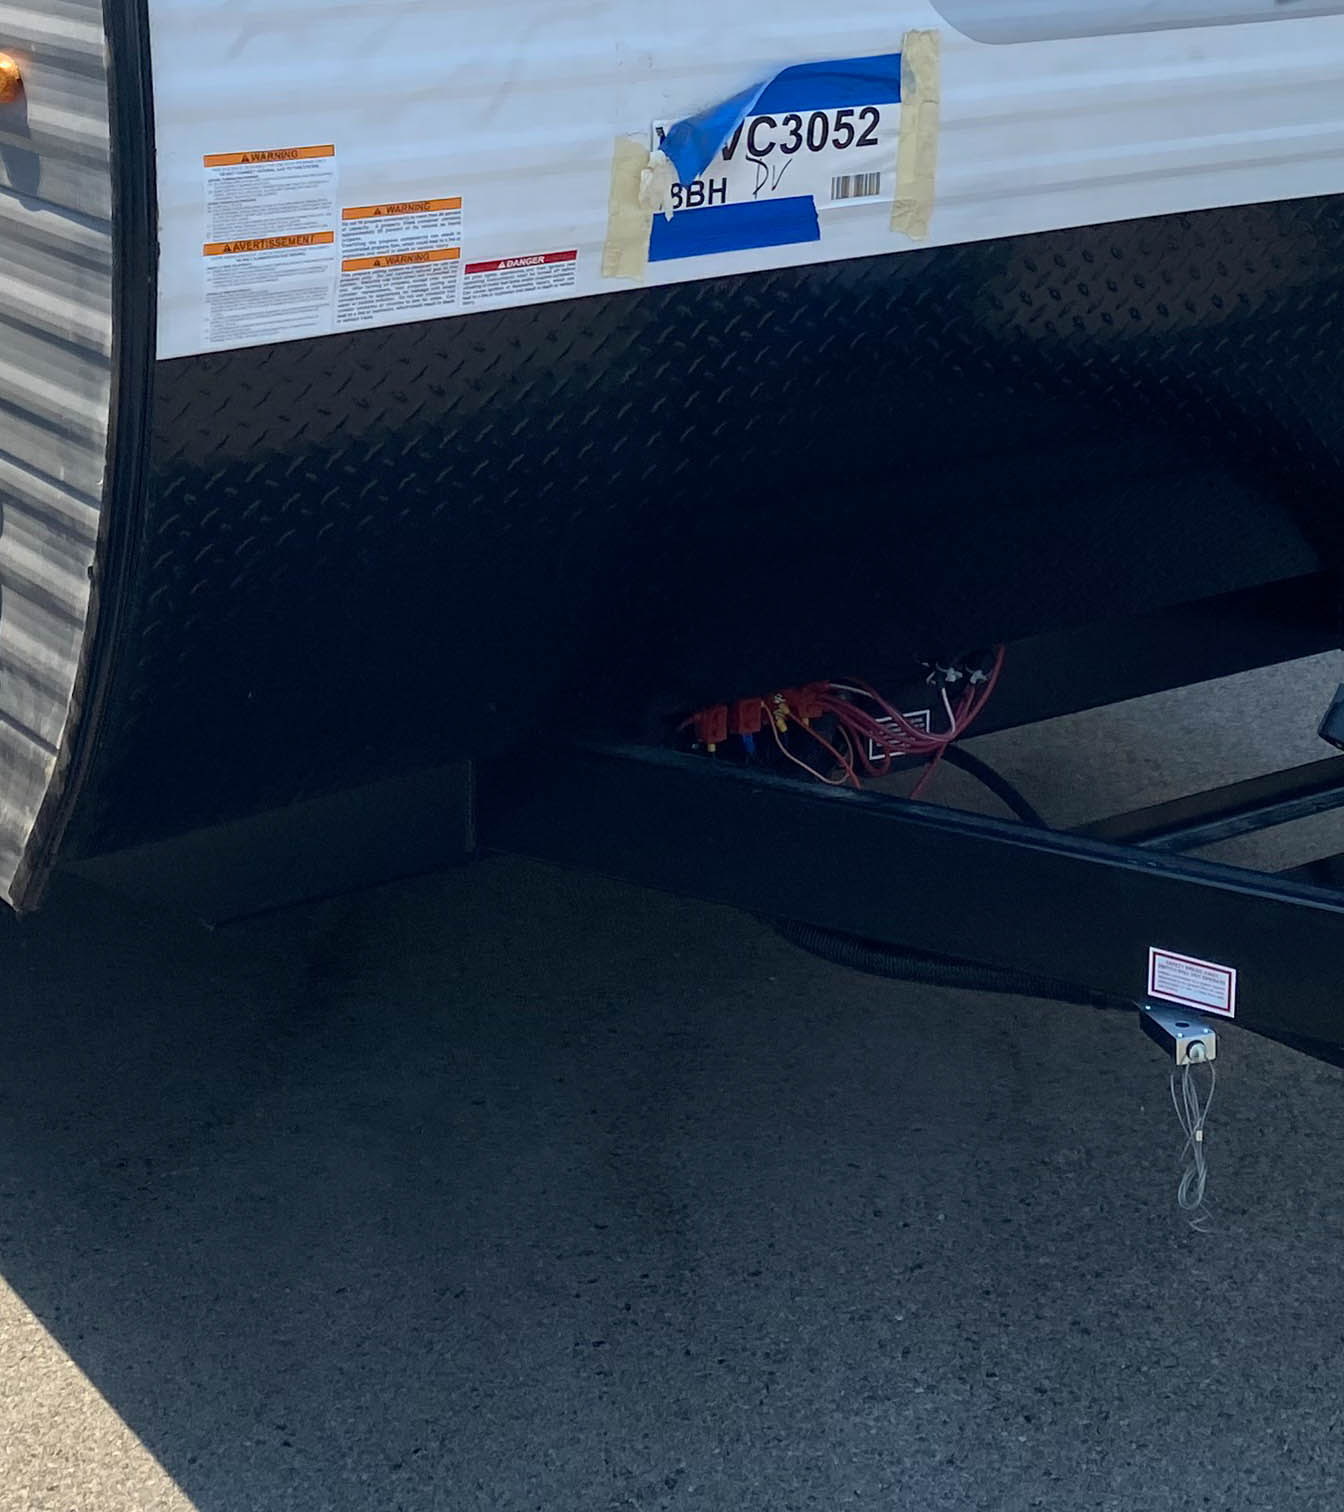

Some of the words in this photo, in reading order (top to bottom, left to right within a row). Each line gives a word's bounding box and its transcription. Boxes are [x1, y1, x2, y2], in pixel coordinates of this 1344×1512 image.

[251, 149, 298, 162] WARNING
[386, 202, 431, 215] WARNING
[233, 233, 314, 253] AVERTISSEMENT
[385, 251, 430, 265] WARNING
[506, 256, 545, 268] DANGER
